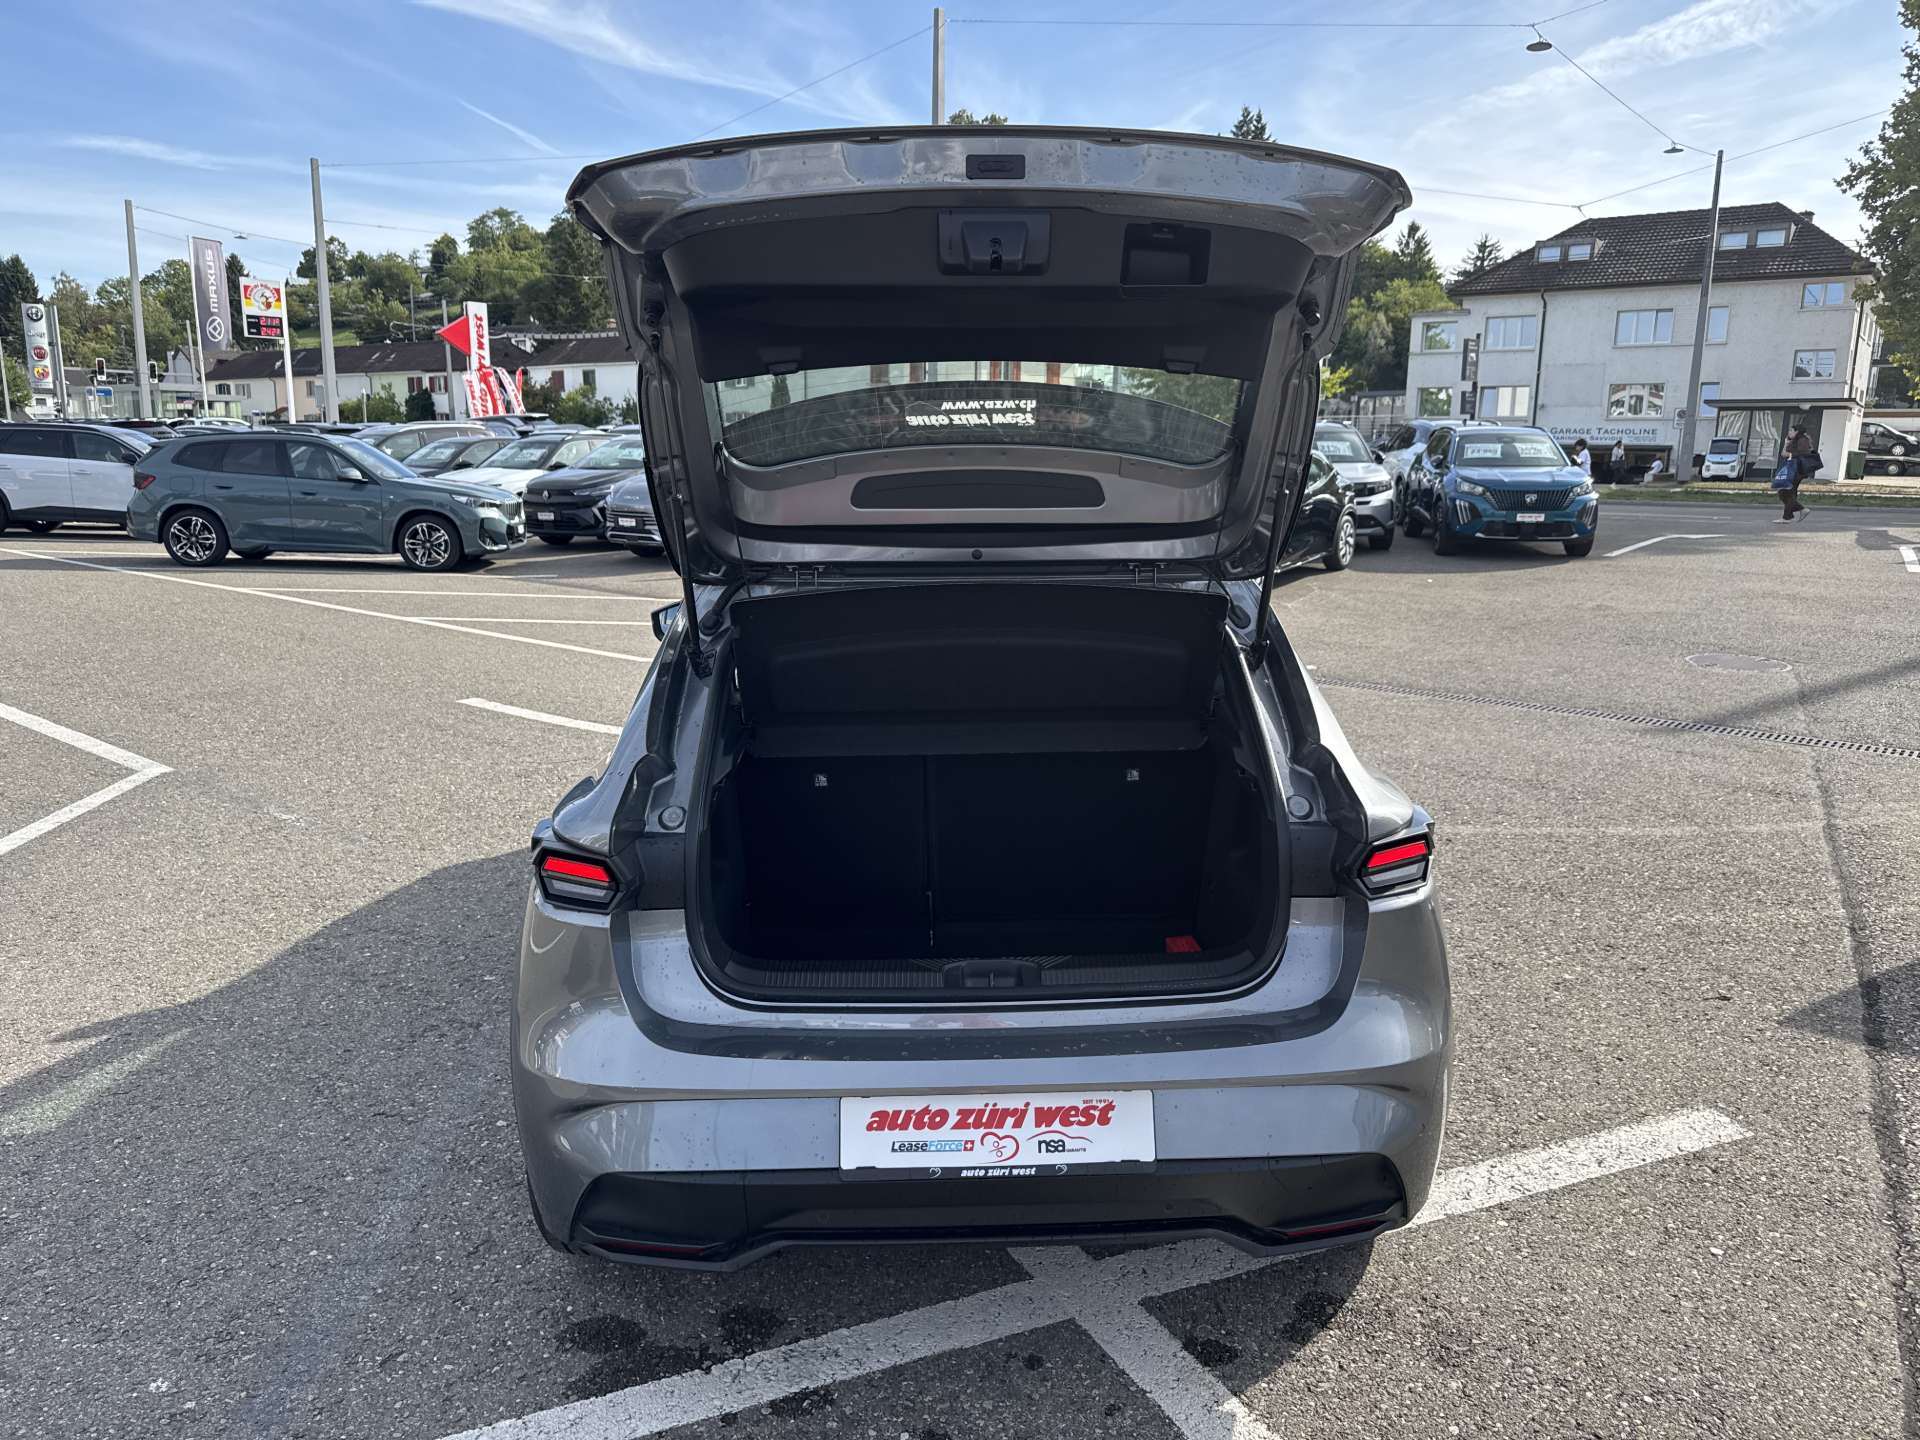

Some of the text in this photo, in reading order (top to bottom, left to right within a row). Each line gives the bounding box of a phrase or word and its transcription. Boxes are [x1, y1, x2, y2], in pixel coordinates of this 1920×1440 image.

[205, 247, 219, 313] MAXUS
[1549, 427, 1658, 435] GARAGE TACHOLINE
[866, 1100, 1116, 1131] auto züri west
[891, 1140, 963, 1152] LeaseForce
[1038, 1139, 1066, 1154] nsa
[960, 1166, 1036, 1177] auto züri west
